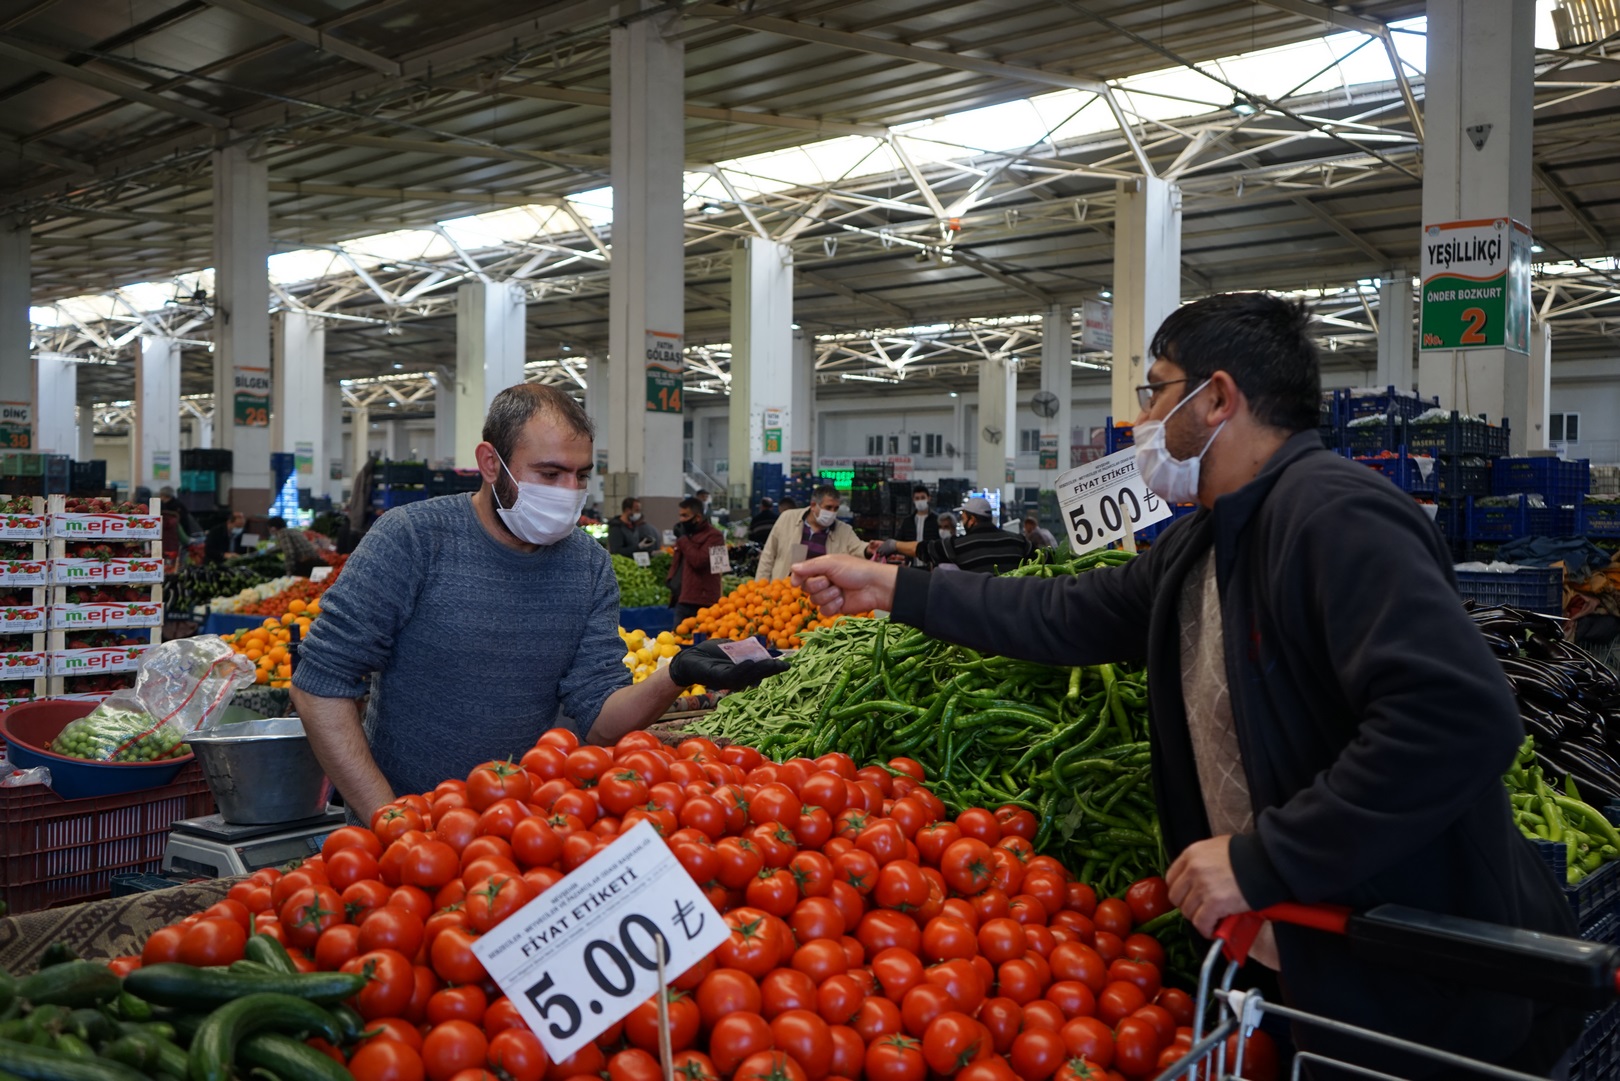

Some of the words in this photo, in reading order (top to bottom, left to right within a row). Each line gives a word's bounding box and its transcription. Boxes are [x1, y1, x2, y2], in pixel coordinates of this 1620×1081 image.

[1427, 233, 1502, 269] YEŞİLLİKÇİ
[1427, 290, 1456, 303] ÖNDER
[1458, 287, 1502, 300] BOZKURT
[1423, 333, 1444, 347] No.
[1460, 307, 1488, 344] 2
[235, 375, 269, 389] BİLGEN
[658, 387, 680, 411] 14
[3, 407, 28, 421] DİNÇ
[246, 407, 268, 425] 26
[9, 433, 29, 448] 38
[1074, 478, 1100, 494] FİYAT
[1101, 462, 1135, 483] ETİKETİ
[1069, 487, 1141, 545] 5.00
[65, 520, 125, 535] m.efe
[67, 564, 126, 579] m.efe
[65, 608, 125, 623] m.efe
[65, 653, 125, 668] m.efe
[521, 919, 569, 957] FİYAT
[572, 868, 639, 921] ETİKETİ
[524, 914, 671, 1039] 5.00
